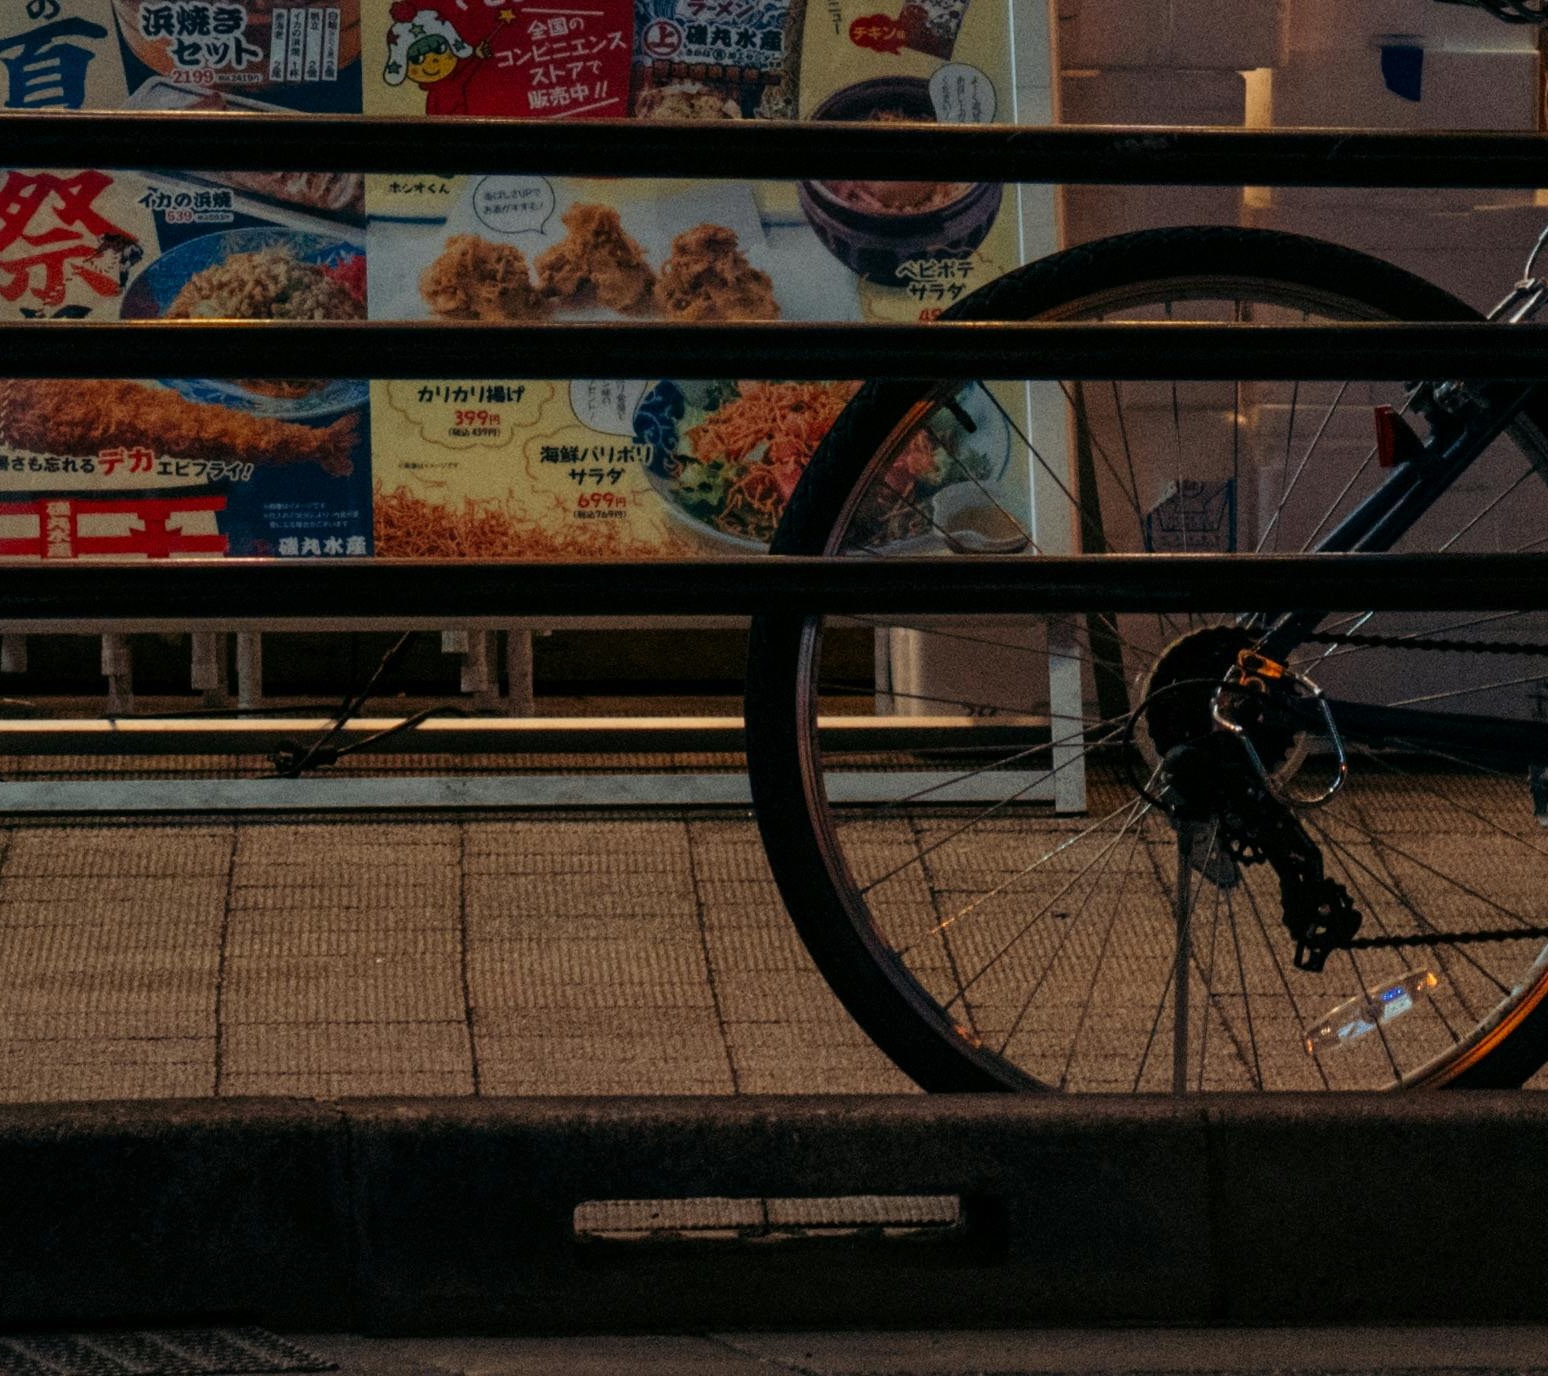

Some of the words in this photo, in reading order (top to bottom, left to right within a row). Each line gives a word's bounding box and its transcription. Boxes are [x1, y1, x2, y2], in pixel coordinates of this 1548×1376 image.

[143, 6, 243, 36] 浜焼き
[528, 17, 585, 39] 全国の
[686, 26, 782, 50] 磯丸水産
[173, 38, 258, 65] セット
[495, 34, 626, 66] コンビニエンス
[173, 70, 214, 83] 2199
[530, 61, 600, 84] ストアで
[418, 386, 525, 403] カリカリ揚げ
[455, 411, 500, 425] 399円
[569, 468, 625, 485] サラダ
[578, 493, 626, 508] 699円
[279, 536, 366, 557] 磯丸水産
